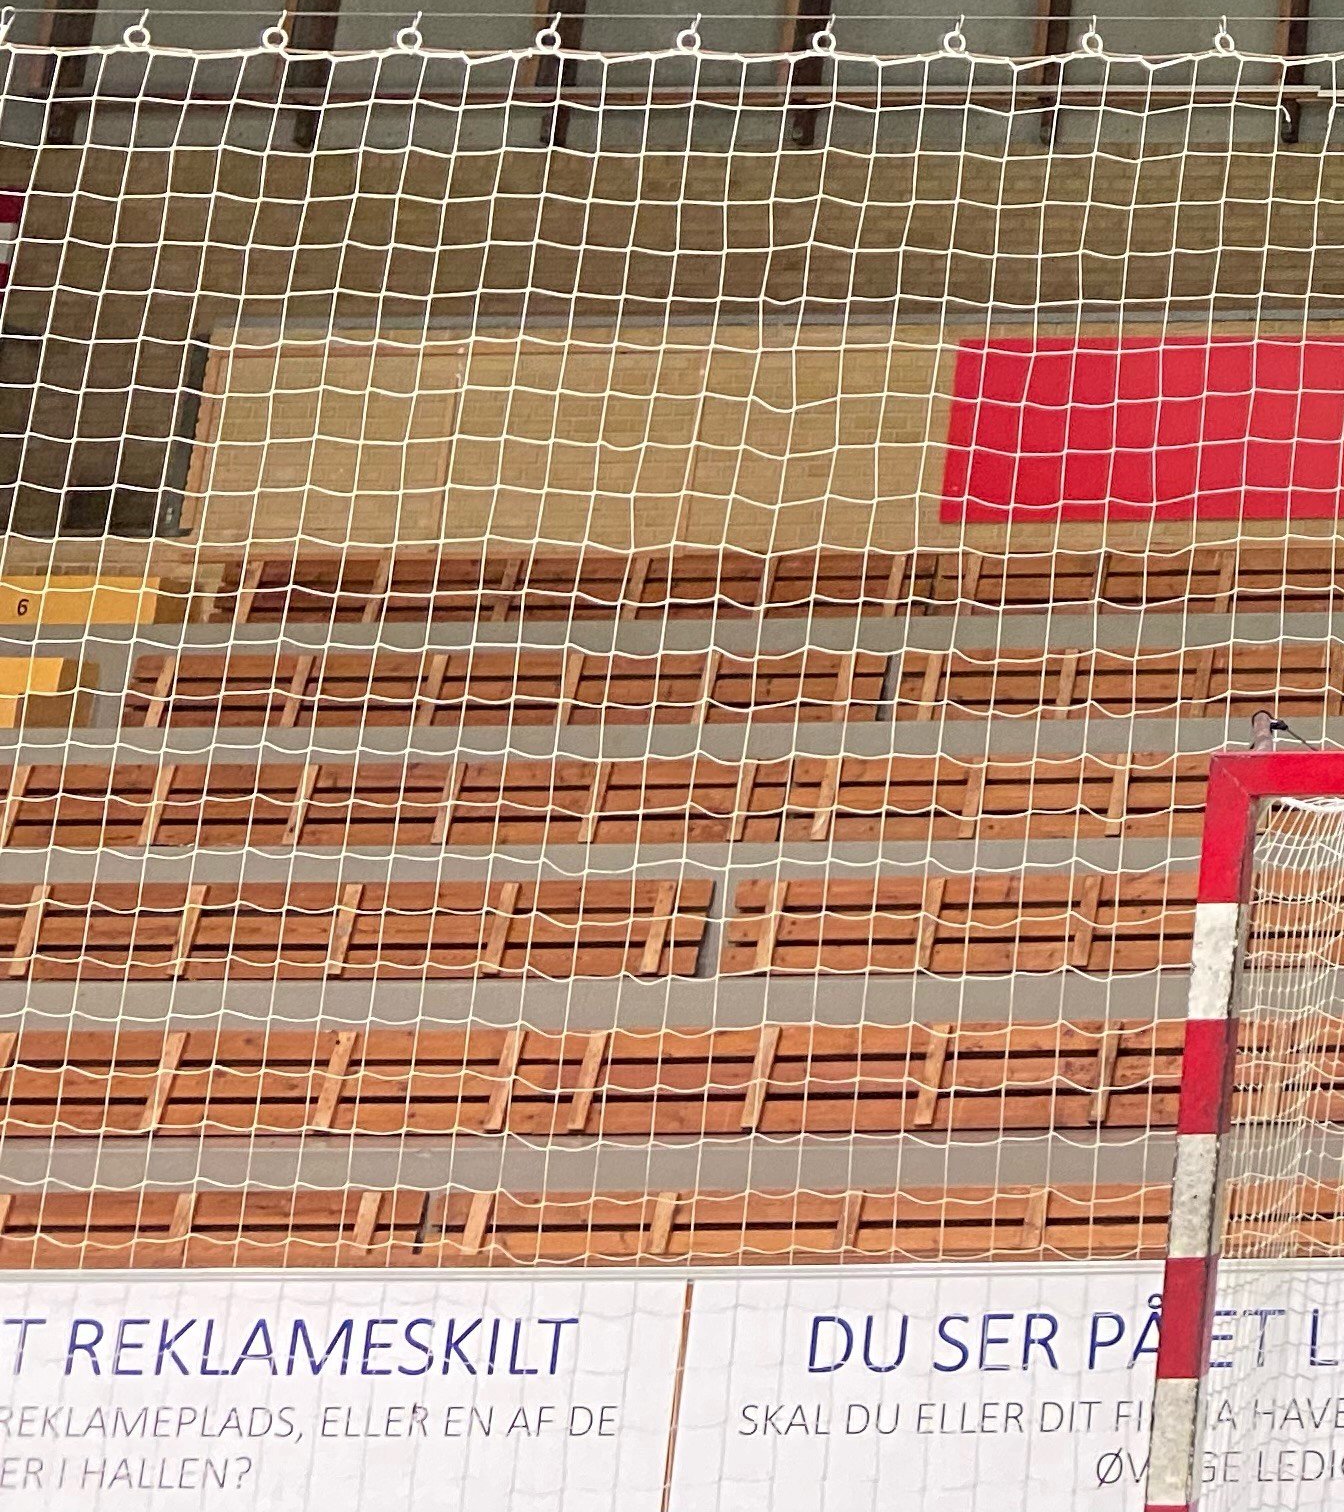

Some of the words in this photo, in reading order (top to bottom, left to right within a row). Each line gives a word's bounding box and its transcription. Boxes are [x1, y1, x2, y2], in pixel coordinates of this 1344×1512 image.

[17, 598, 29, 616] 6
[64, 1317, 579, 1377] REKLAMESKILT
[807, 1313, 909, 1374] DU
[932, 1311, 1060, 1373] SER
[0, 1404, 304, 1444] REKLAMEPLADS,
[321, 1404, 429, 1438] ELLER
[443, 1404, 493, 1437] EN
[505, 1404, 555, 1438] AF
[568, 1404, 619, 1437] DE
[739, 1402, 831, 1437] SKAL
[846, 1401, 902, 1436] DU
[916, 1400, 1025, 1435] ELLER
[1039, 1399, 1101, 1433] DIT
[1114, 1398, 1237, 1432] FIA
[81, 1455, 253, 1490] HALLEN?
[1096, 1446, 1243, 1487] ØVGE
